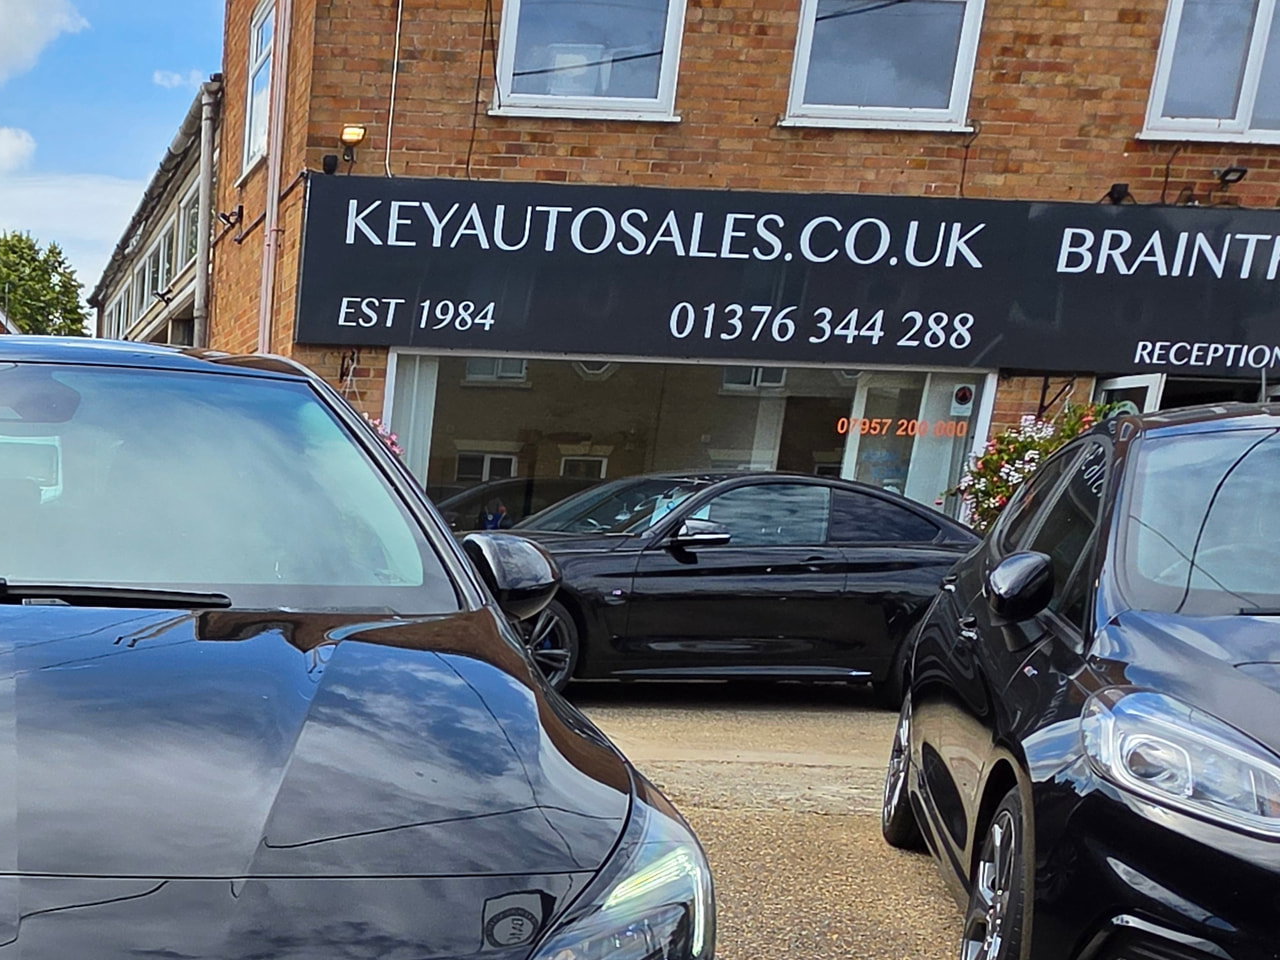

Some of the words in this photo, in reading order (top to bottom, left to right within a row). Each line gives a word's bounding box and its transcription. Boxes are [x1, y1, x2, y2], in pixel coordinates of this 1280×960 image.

[344, 198, 986, 269] KEYAUTOSALES.CO.UK
[337, 297, 406, 328] EST
[419, 300, 496, 331] 1984
[669, 302, 797, 343] 01376
[808, 307, 885, 346] 344
[896, 311, 975, 350] 288
[837, 417, 893, 435] 07957
[895, 419, 929, 436] 200
